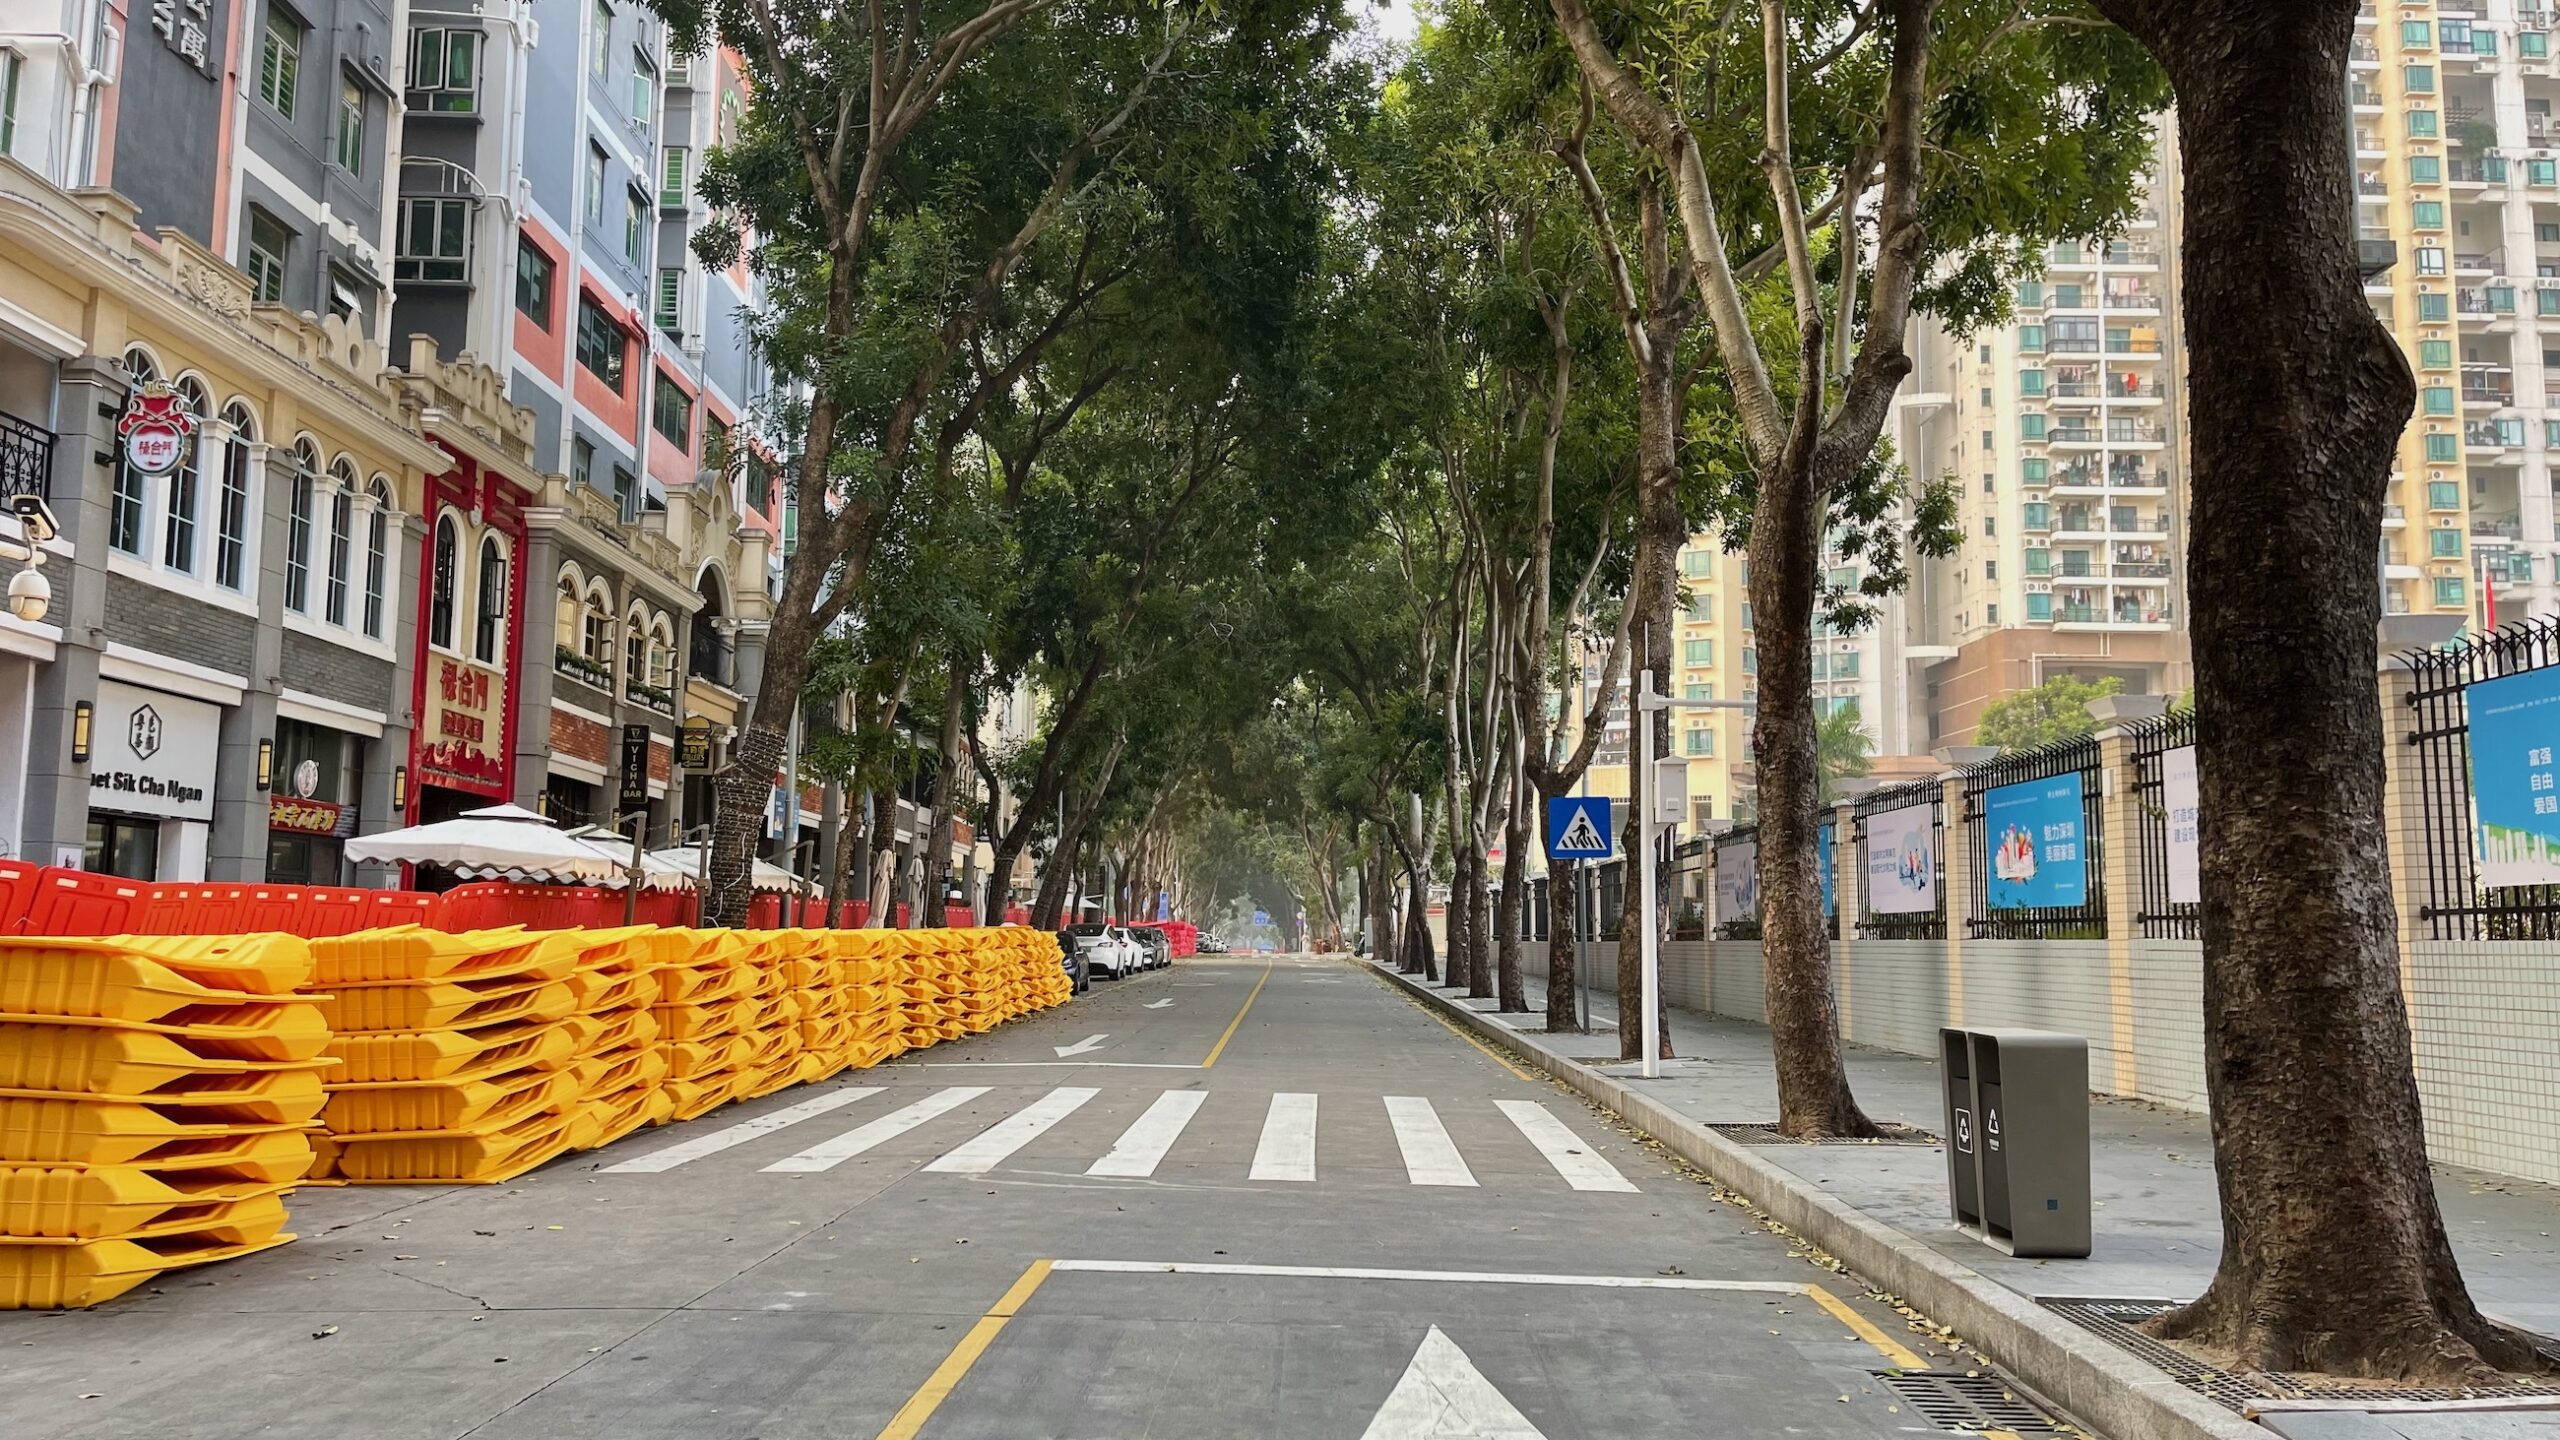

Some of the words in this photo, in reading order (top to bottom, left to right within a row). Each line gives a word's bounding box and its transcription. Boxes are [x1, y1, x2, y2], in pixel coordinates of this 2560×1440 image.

[2529, 747, 2552, 767] 富强
[629, 746, 639, 789] VICHA
[113, 772, 136, 792] Sik
[139, 776, 165, 796] Cha
[167, 780, 203, 803] Ngan
[2531, 772, 2553, 791] 自由
[2534, 796, 2557, 814] 爱国
[2044, 821, 2075, 841] 魅力深圳
[2045, 843, 2076, 862] 美丽家园
